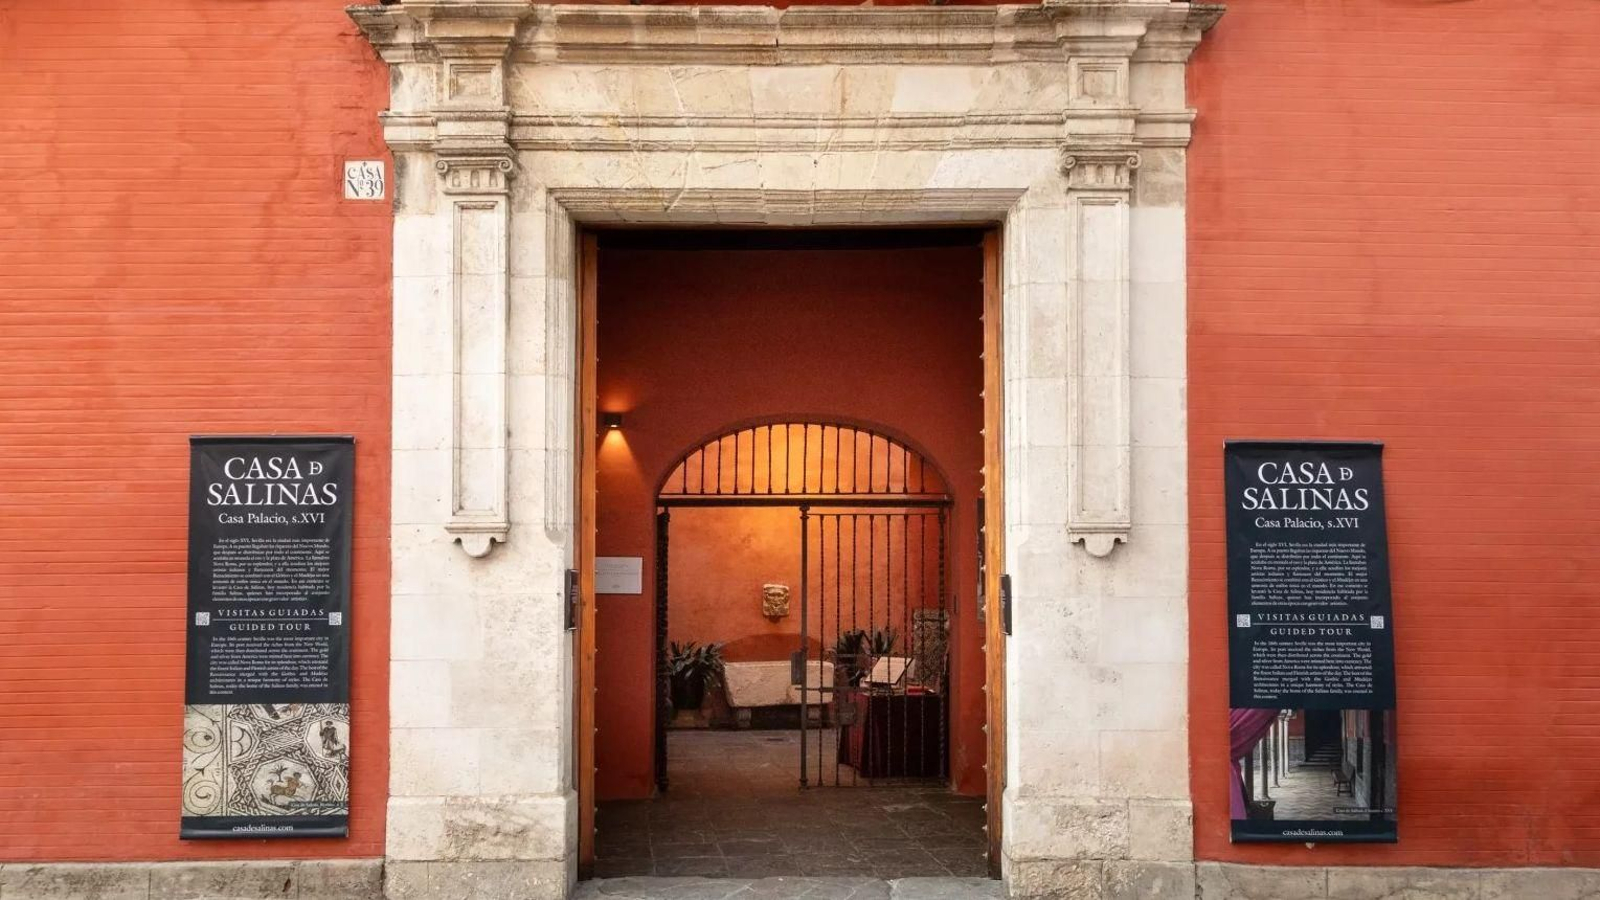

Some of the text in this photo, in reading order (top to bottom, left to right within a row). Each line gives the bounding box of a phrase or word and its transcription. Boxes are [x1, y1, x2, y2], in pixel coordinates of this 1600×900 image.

[348, 166, 382, 179] CASA
[224, 456, 304, 480] CASA
[1258, 462, 1335, 484] CASA
[207, 482, 337, 506] SALINAS
[1242, 488, 1368, 510] SALINAS
[218, 513, 325, 525] Casa Palacio, s.XVI
[1255, 517, 1359, 530] Casa Palacio, s.XVI
[268, 608, 324, 616] GUIADAS
[1308, 614, 1365, 622] GUIADAS
[232, 824, 294, 832] casadesalinas.com
